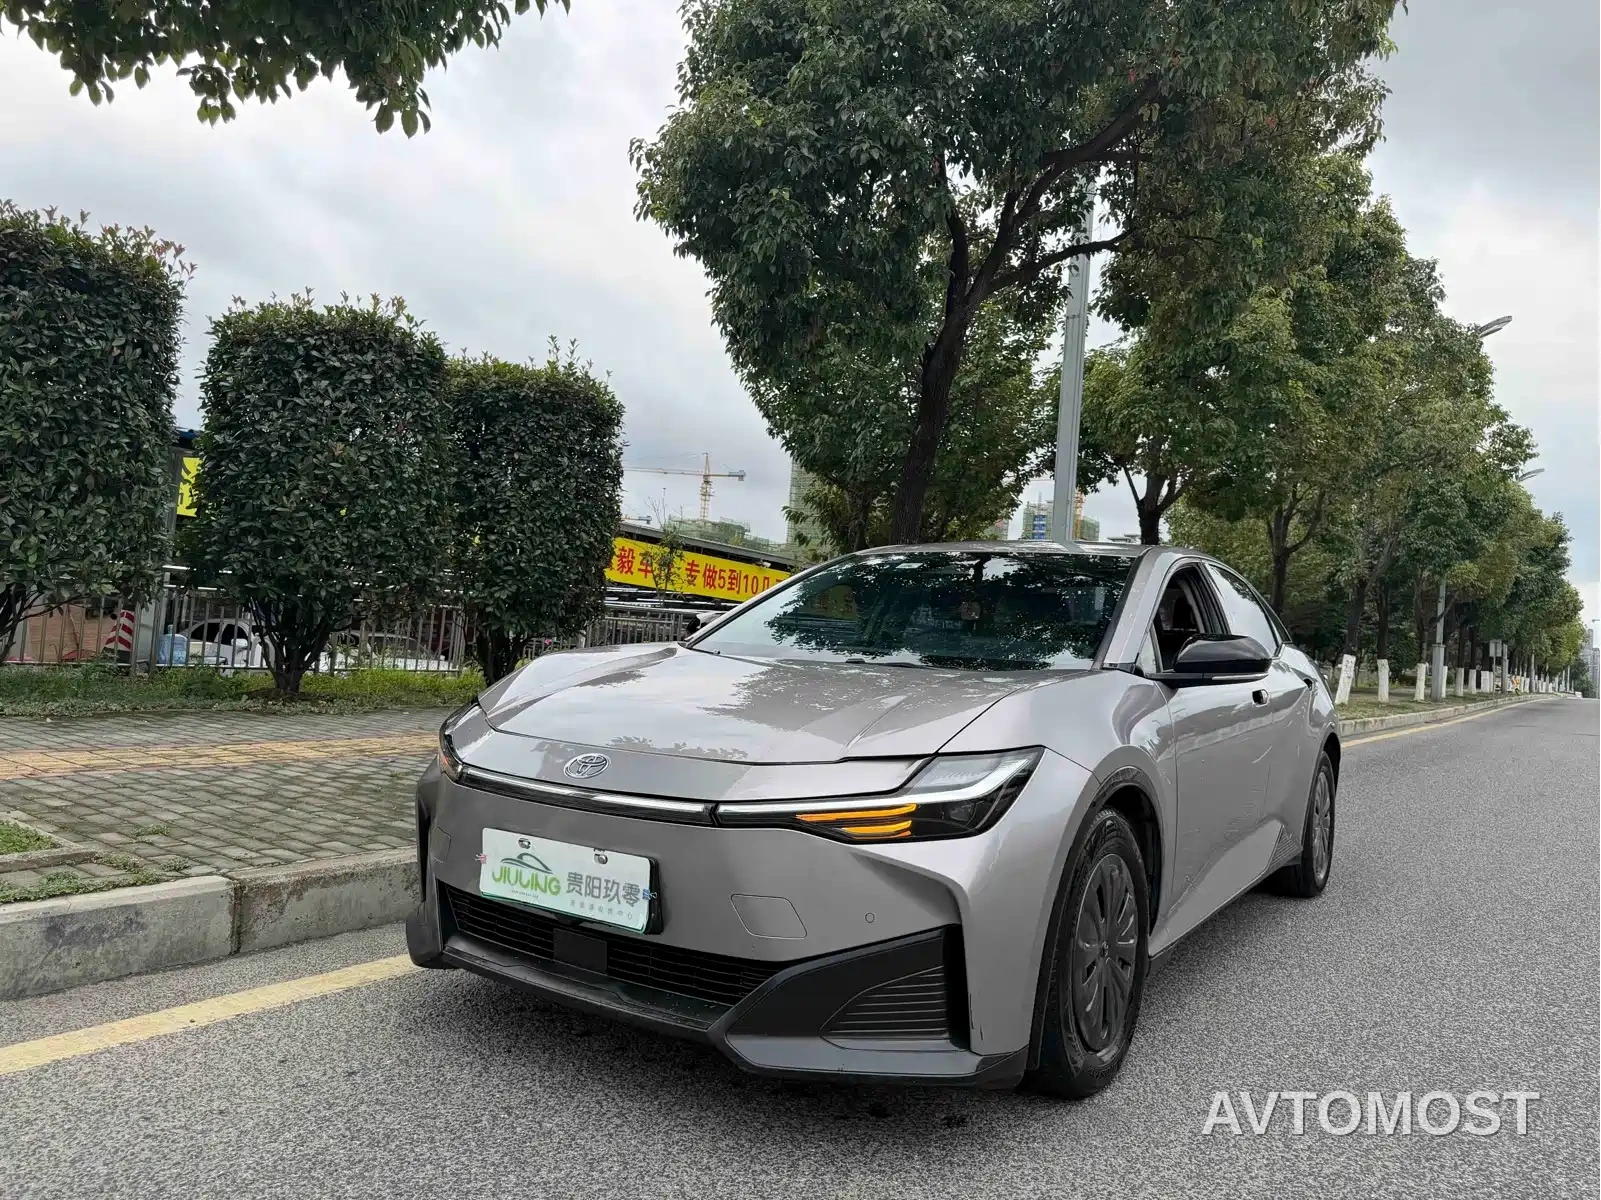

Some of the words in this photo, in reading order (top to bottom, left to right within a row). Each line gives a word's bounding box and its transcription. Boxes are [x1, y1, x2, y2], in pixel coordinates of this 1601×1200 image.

[492, 866, 561, 896] JIULING
[566, 872, 640, 908] 贵阳玖零
